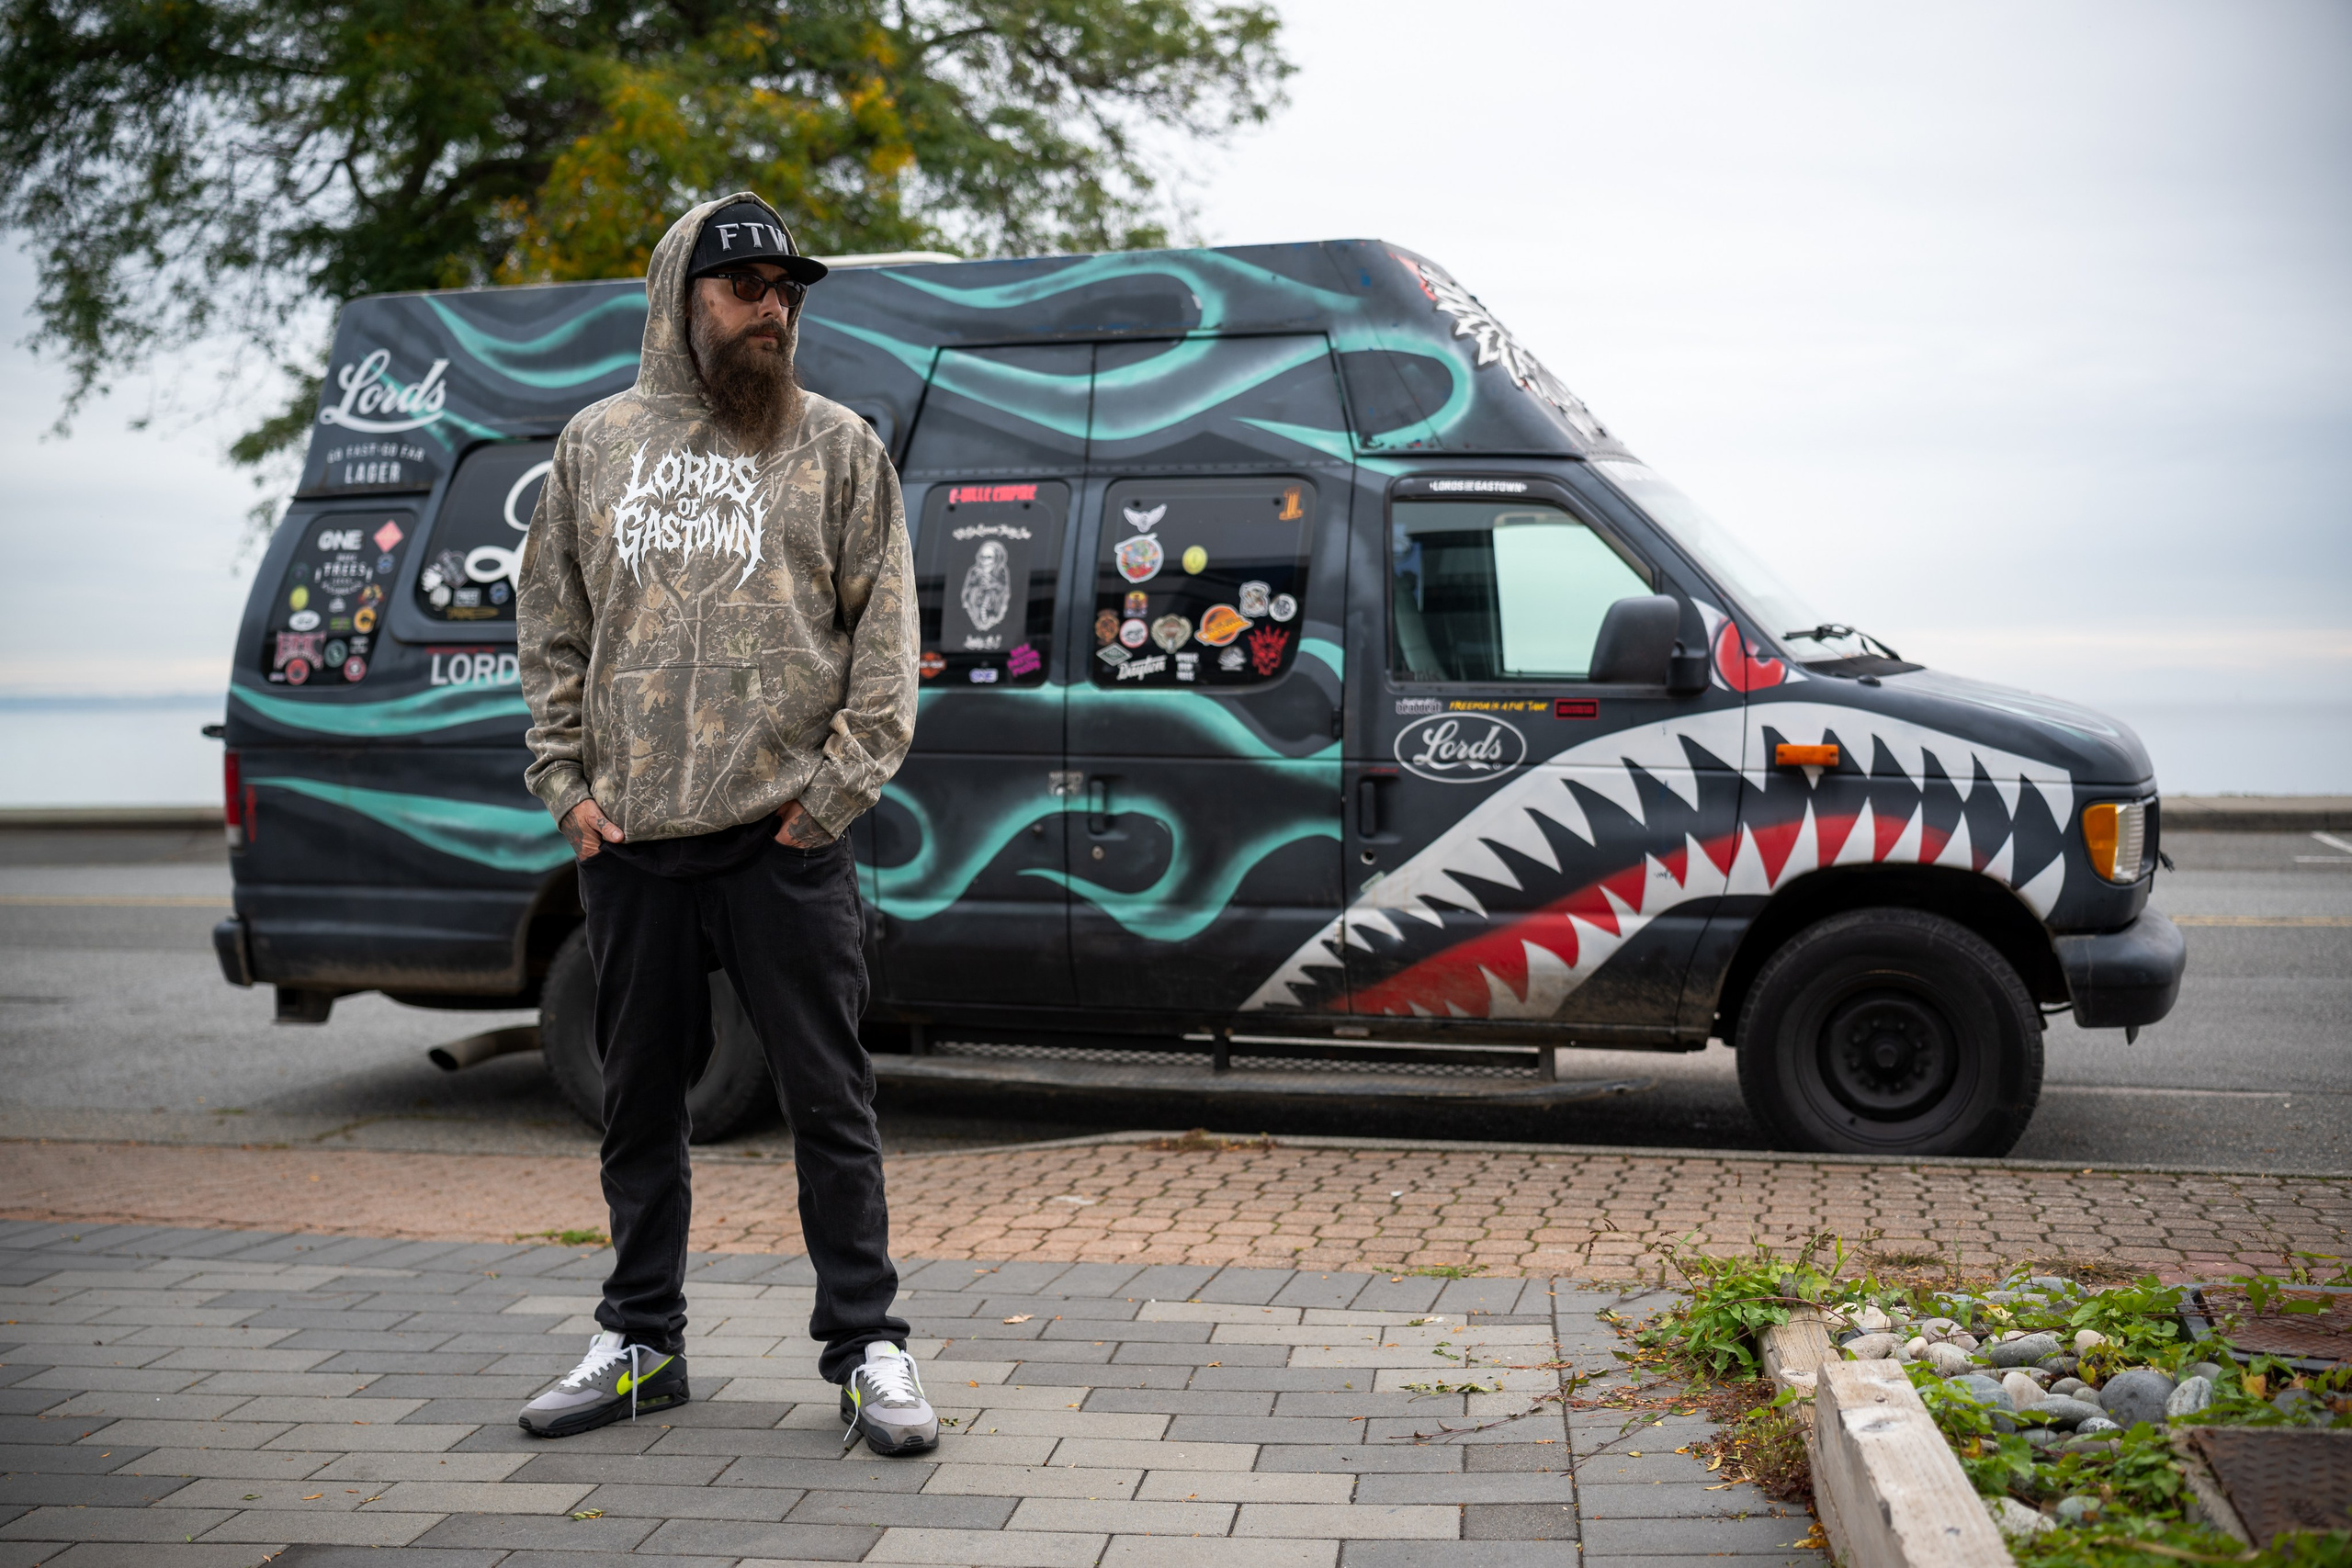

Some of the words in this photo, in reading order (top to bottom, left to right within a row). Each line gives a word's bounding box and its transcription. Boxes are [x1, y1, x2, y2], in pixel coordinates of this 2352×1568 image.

[715, 222, 789, 255] FTW
[319, 348, 450, 434] Lords
[345, 461, 401, 484] LAGER
[620, 437, 763, 514] LORDS
[1432, 480, 1464, 491] LORDS
[1474, 480, 1521, 493] GASTOWN
[677, 497, 701, 517] OF
[317, 529, 363, 551] ONE
[611, 490, 769, 591] GASTOWN
[323, 561, 367, 577] TREES
[970, 669, 998, 682] ONE
[1116, 655, 1168, 681] Dayton
[1412, 719, 1502, 770] Lords
